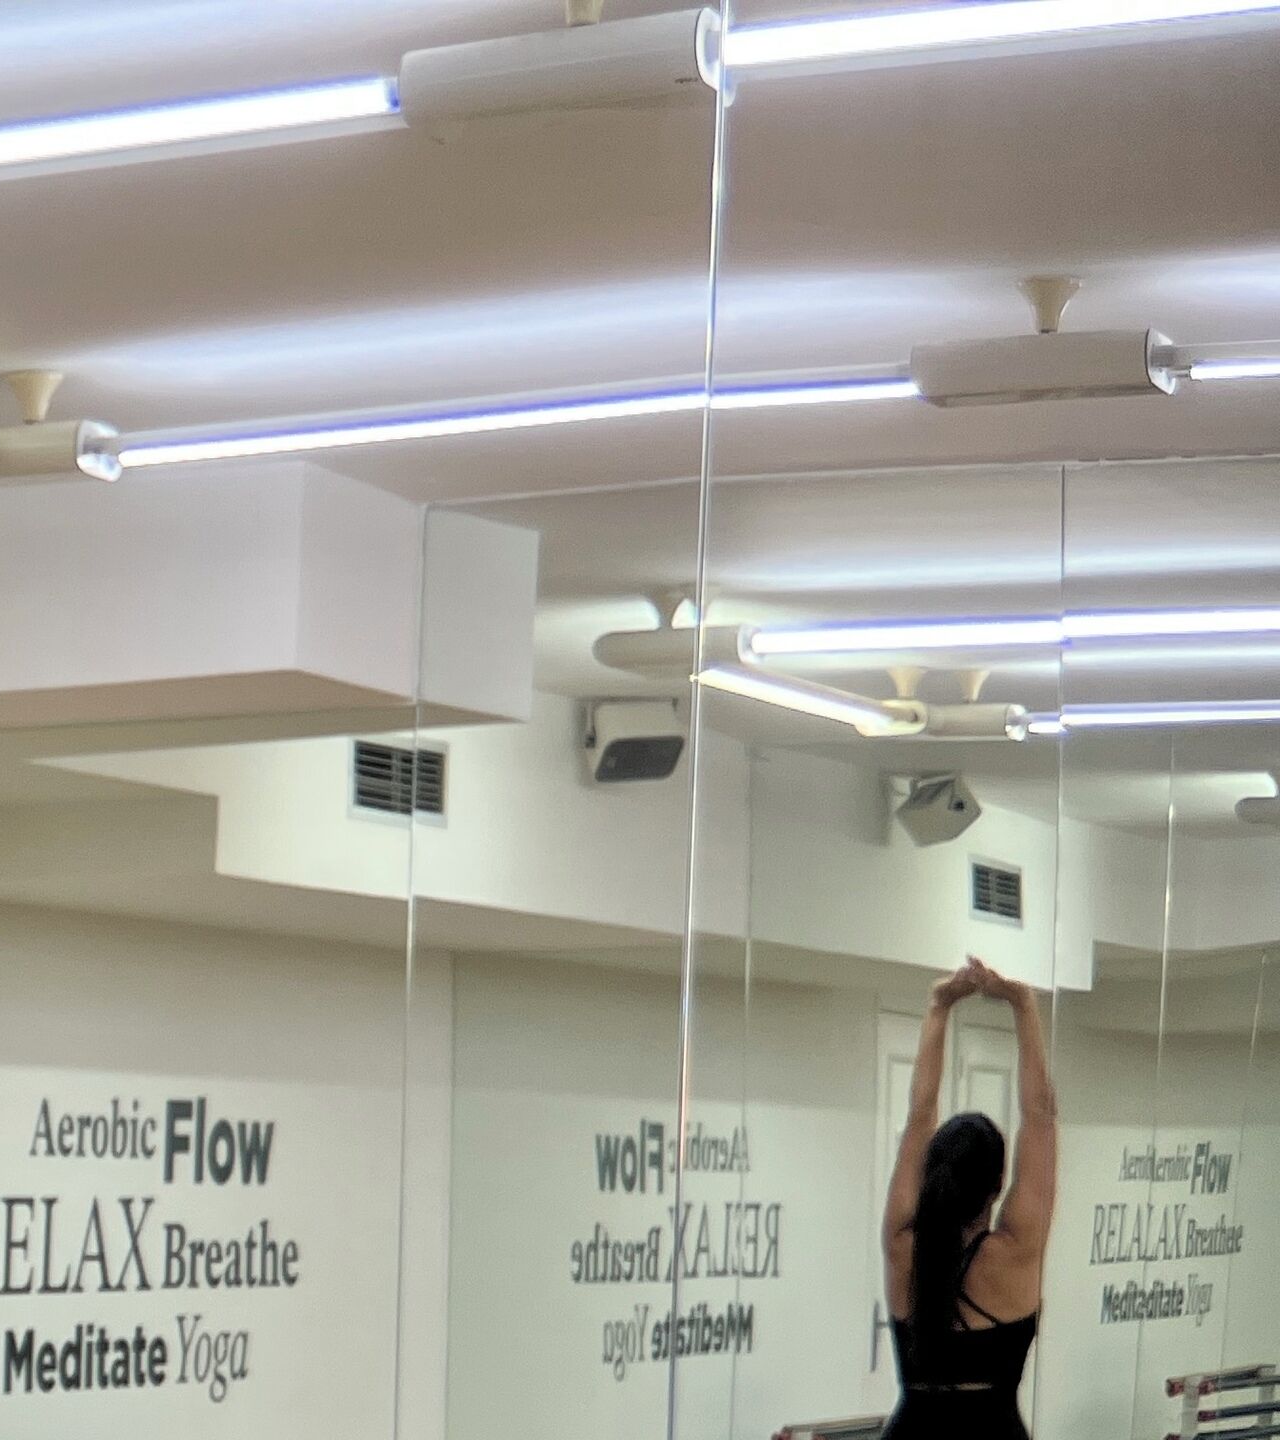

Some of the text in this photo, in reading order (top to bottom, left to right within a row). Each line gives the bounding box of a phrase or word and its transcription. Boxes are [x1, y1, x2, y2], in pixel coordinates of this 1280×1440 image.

[29, 1095, 275, 1186] Aerobic Flow
[161, 1218, 301, 1290] Breathe
[3, 1313, 250, 1403] Meditate Yoga
